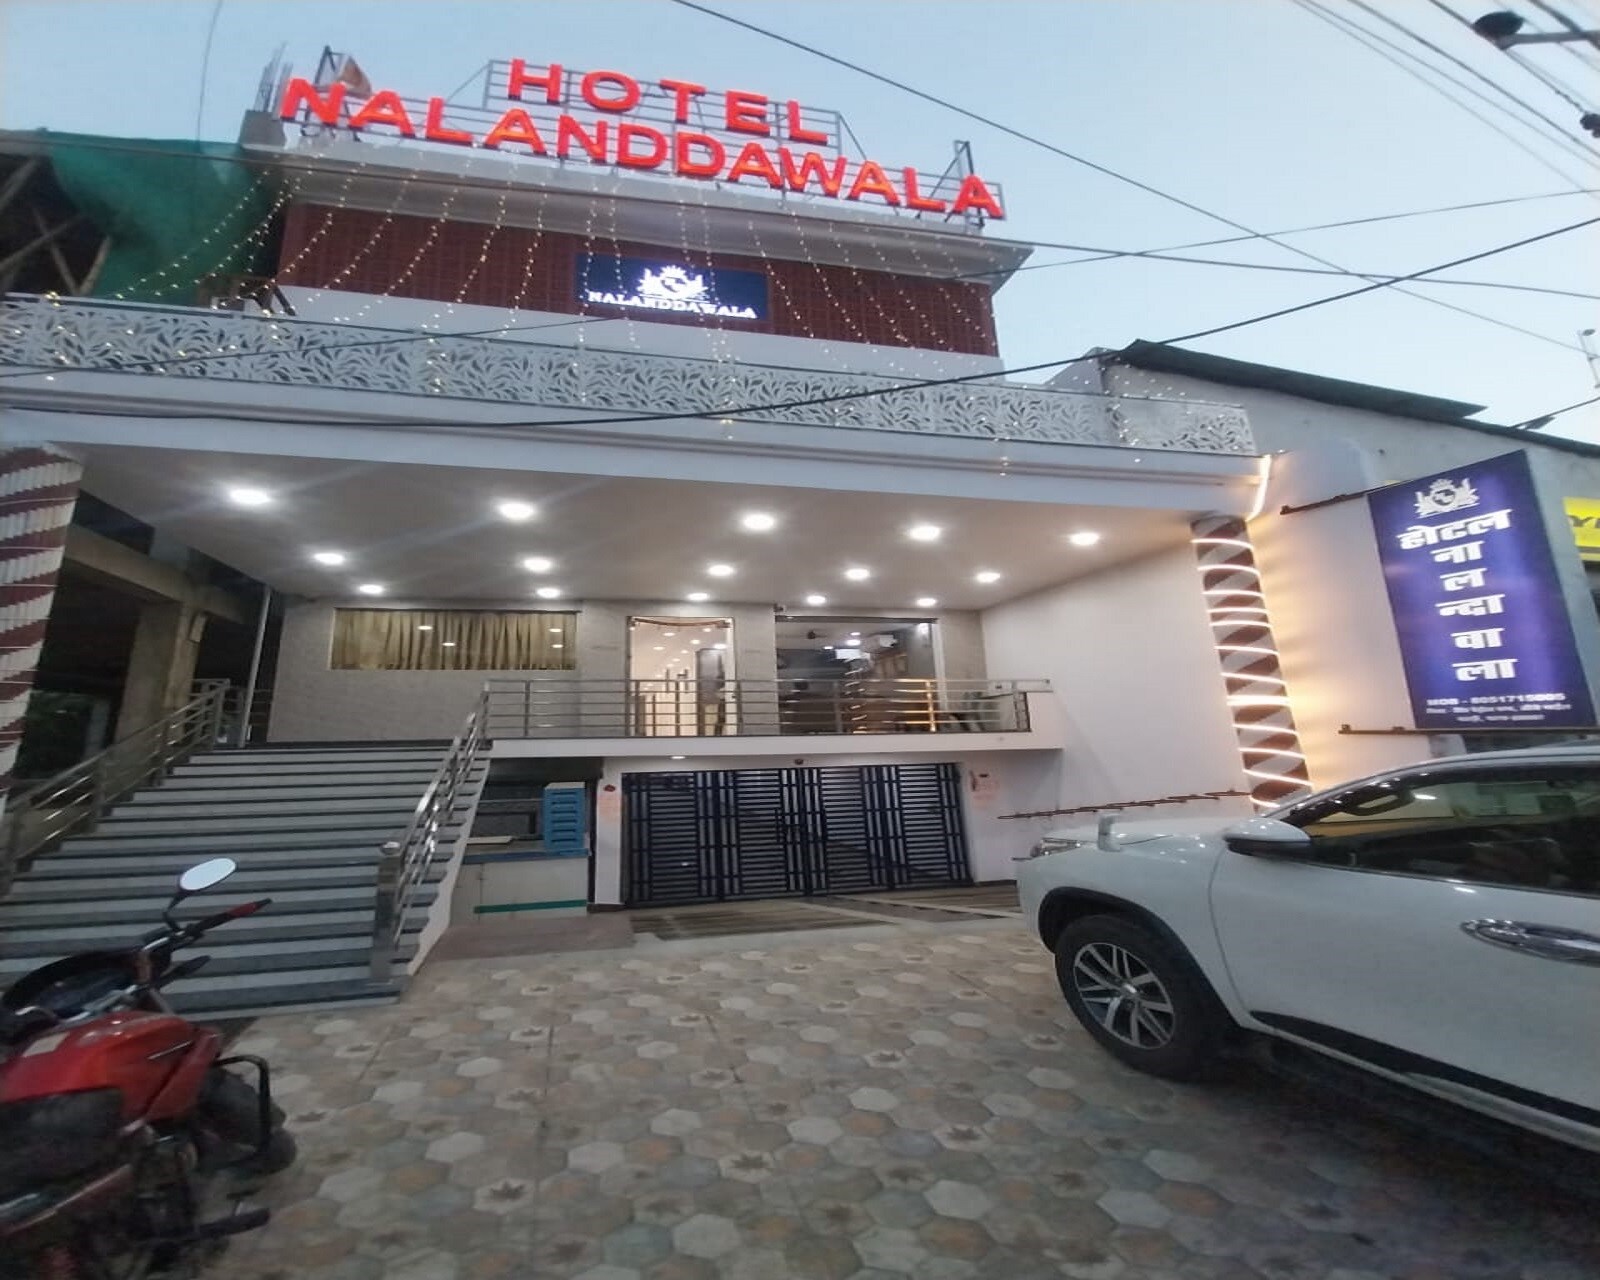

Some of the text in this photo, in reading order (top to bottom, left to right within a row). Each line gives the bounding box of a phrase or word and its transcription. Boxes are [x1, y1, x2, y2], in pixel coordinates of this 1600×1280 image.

[508, 58, 828, 144] HOTEL
[279, 77, 1003, 219] NALANDDAWALA
[587, 290, 758, 319] NALANDDAWALA
[1397, 508, 1513, 550] होटल
[1430, 540, 1485, 564] ना
[1439, 567, 1487, 592] ल
[1451, 658, 1518, 682] ला
